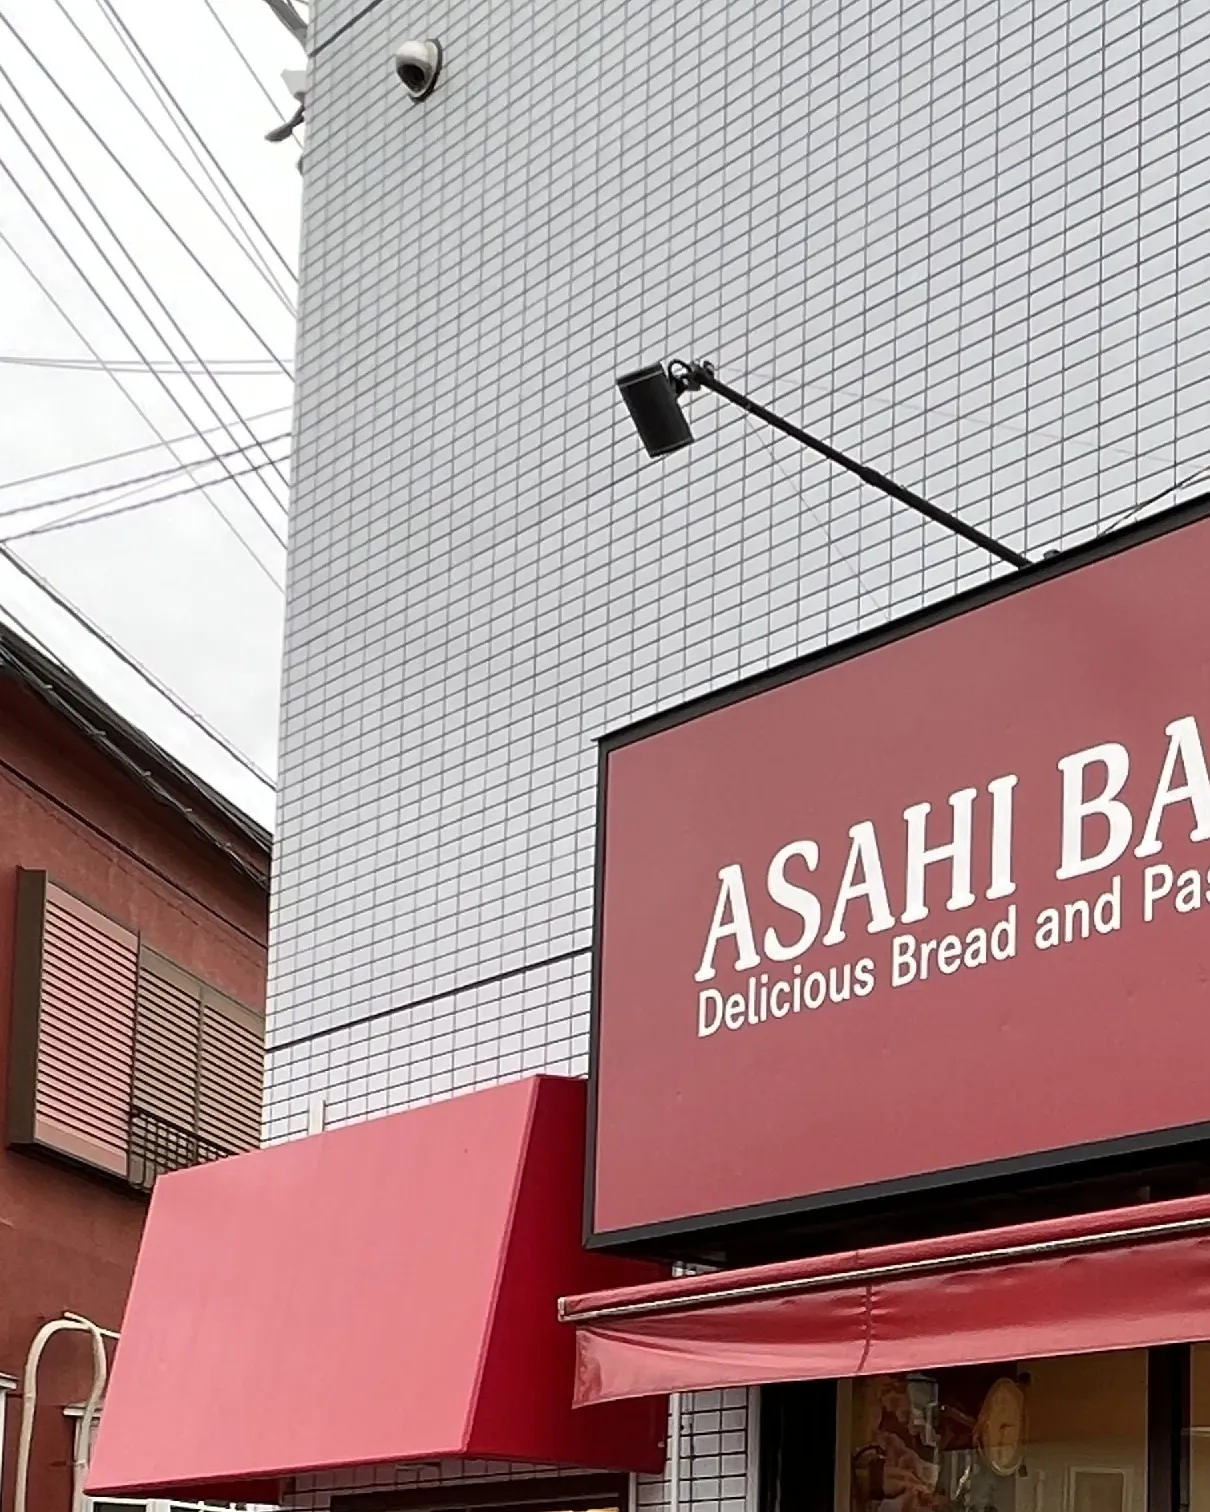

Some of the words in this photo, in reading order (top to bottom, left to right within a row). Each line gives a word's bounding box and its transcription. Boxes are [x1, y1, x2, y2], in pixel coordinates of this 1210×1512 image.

[695, 775, 1018, 982] ASAHI
[698, 958, 875, 1037] Delicious
[891, 905, 1017, 987] Bread
[1035, 875, 1121, 949] and
